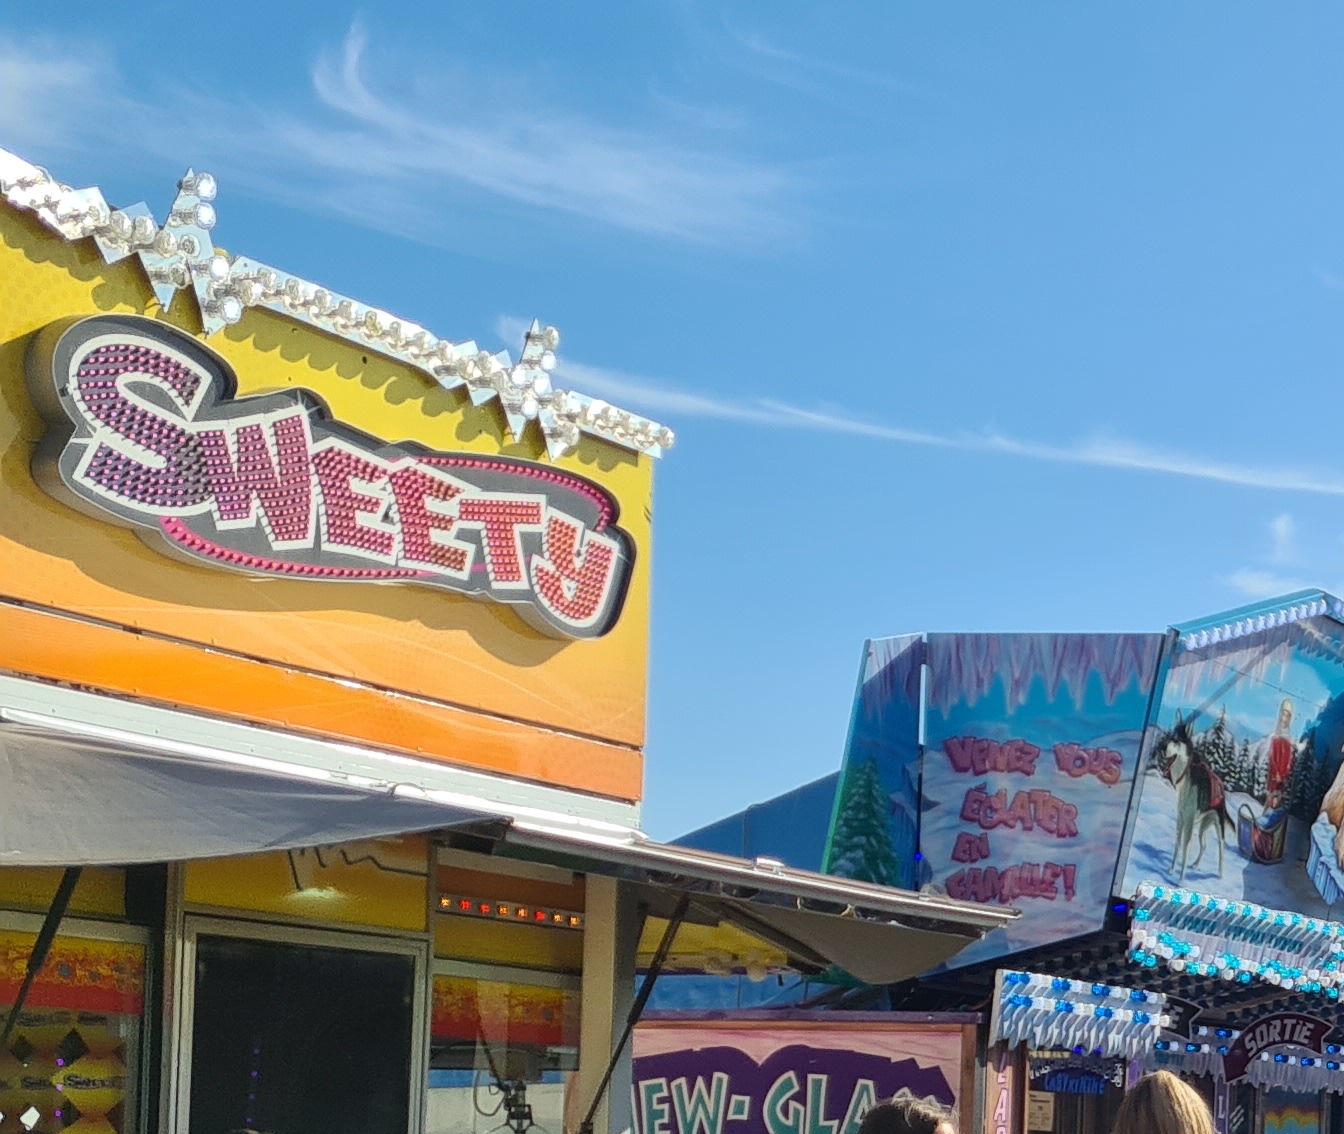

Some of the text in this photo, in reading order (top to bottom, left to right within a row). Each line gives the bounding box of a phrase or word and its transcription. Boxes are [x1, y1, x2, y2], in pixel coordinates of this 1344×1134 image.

[66, 332, 620, 626] SWEETY
[944, 736, 1124, 785] VENEZ VOUS
[960, 782, 1079, 839] ÉCLATER
[951, 831, 991, 864] EN
[1244, 1019, 1314, 1058] SORTIE
